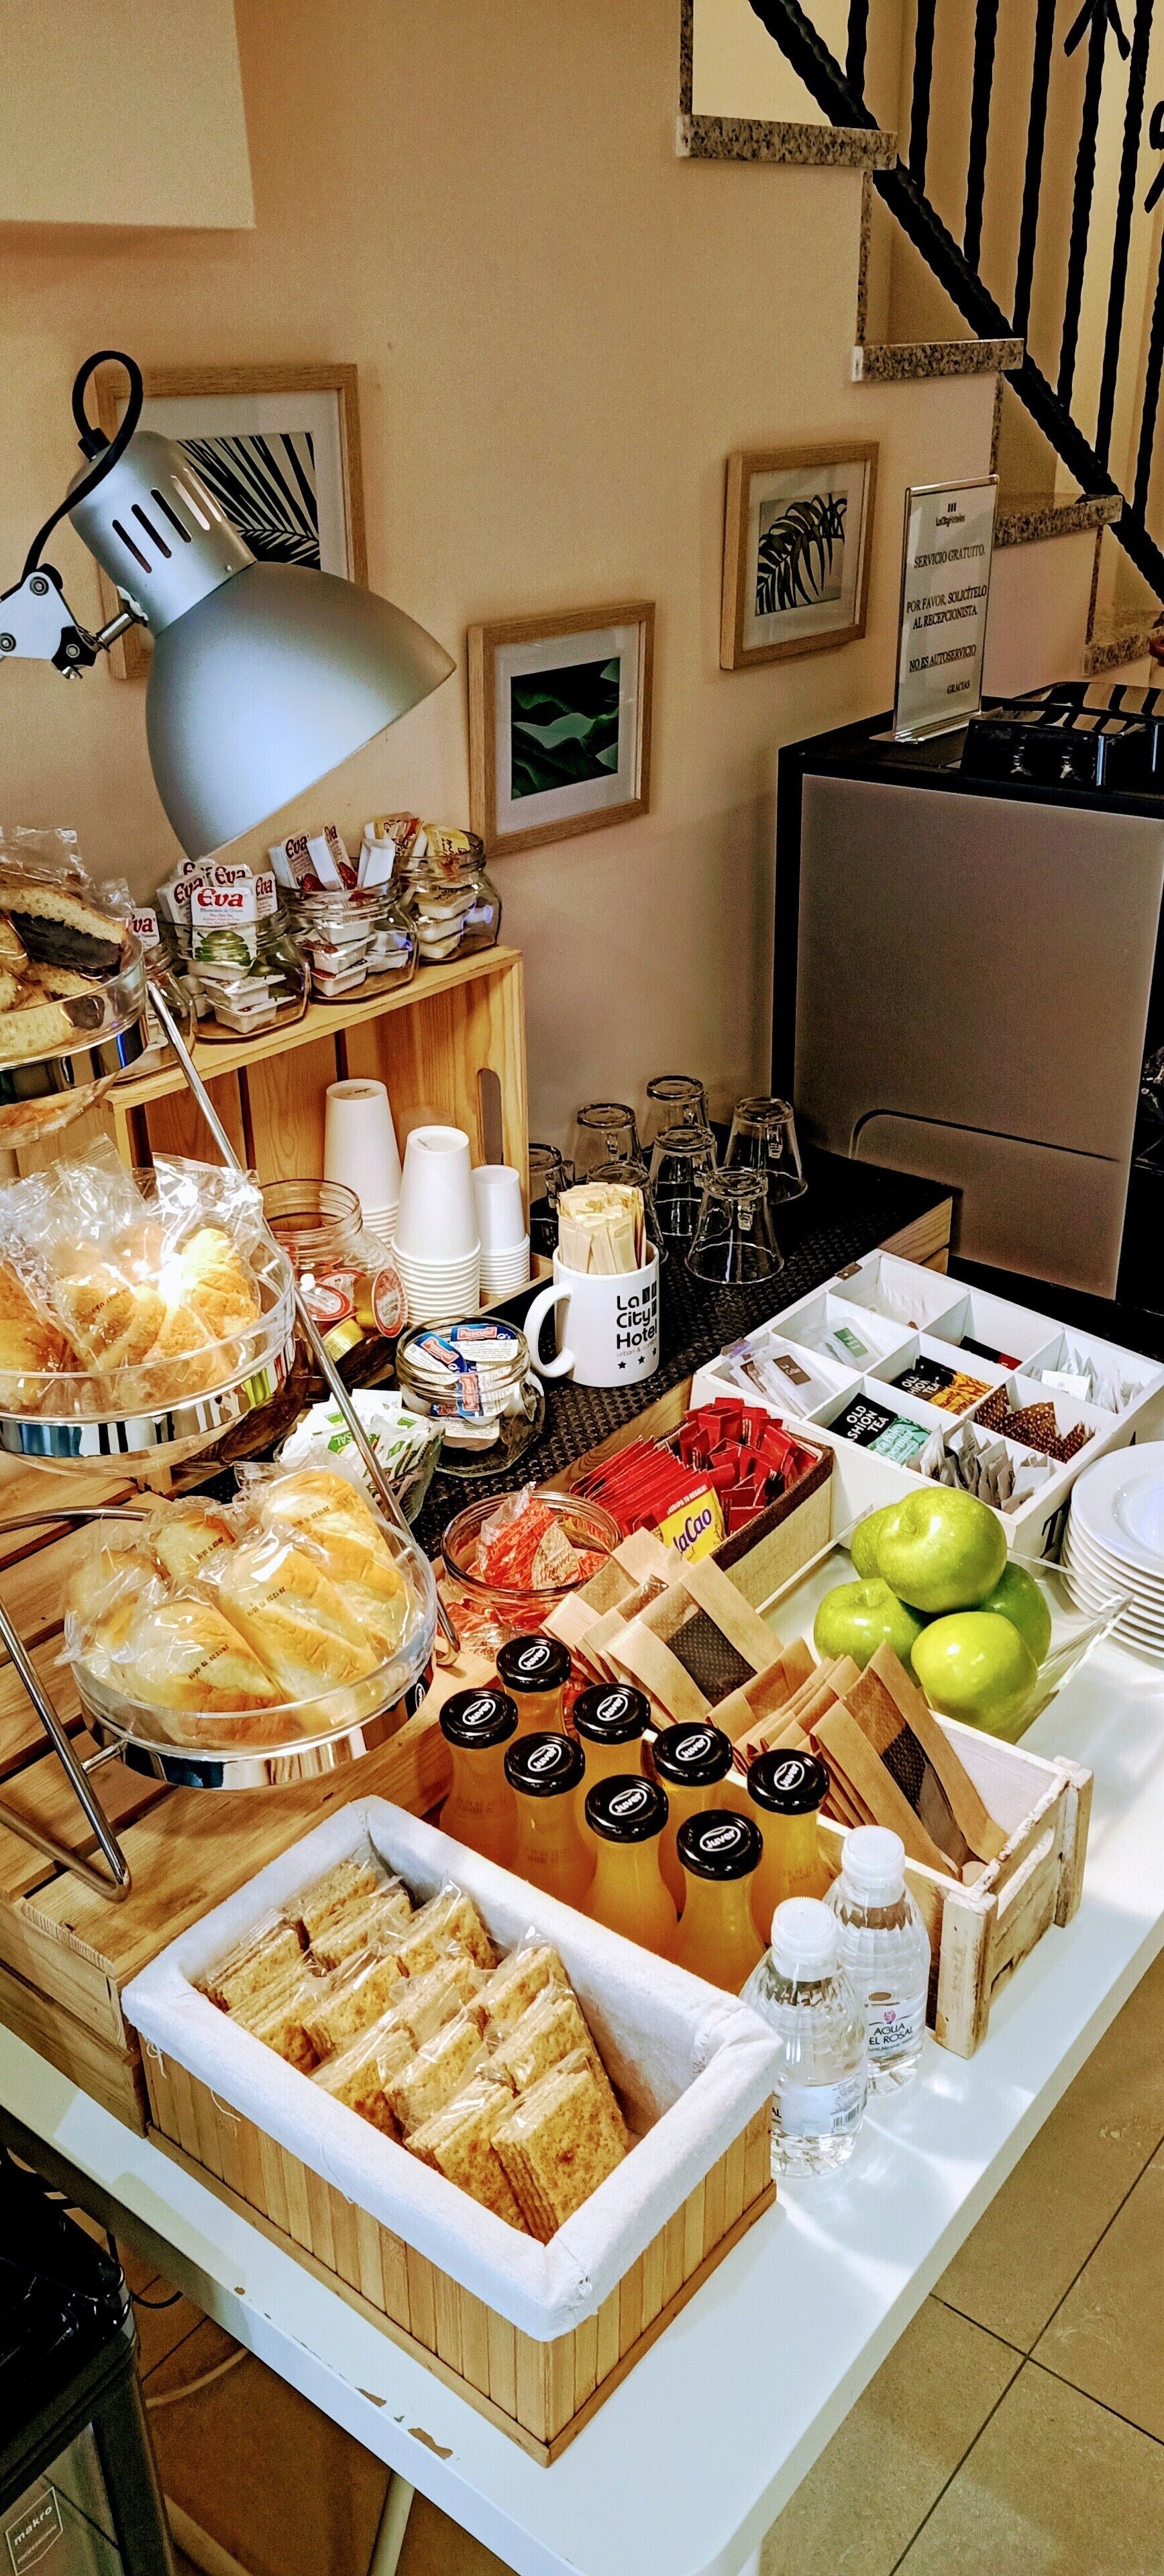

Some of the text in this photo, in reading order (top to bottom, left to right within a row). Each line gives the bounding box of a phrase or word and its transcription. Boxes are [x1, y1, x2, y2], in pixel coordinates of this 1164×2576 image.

[913, 551, 947, 569] SERVICIO
[906, 600, 921, 613] POR
[947, 585, 987, 604] SOLICÍTELO
[913, 616, 923, 629] AL
[909, 644, 977, 672] NO ES AUTOSERVICIO
[947, 680, 971, 694] GRACIAS
[286, 836, 307, 859] Eva
[215, 866, 246, 885] Eva
[174, 877, 204, 904] Eva
[255, 877, 273, 896] Eva
[197, 888, 244, 907] Eva
[132, 914, 154, 932] va
[617, 1295, 640, 1311] La
[617, 1307, 651, 1329] City
[617, 1318, 657, 1350] Hotel
[846, 1405, 867, 1423] OLD
[867, 1416, 889, 1432] TEA
[333, 1432, 352, 1446] SAL
[523, 1648, 545, 1668] Juver
[468, 1702, 491, 1722] Juver
[602, 1697, 624, 1718] Juver
[533, 1746, 557, 1769] Juver
[681, 1737, 706, 1758] Juver
[779, 1764, 799, 1787] Juver
[615, 1792, 642, 1813] Juver
[706, 1829, 736, 1849] Juver
[874, 2023, 905, 2036] AGUA
[884, 2026, 913, 2044] ROSAL
[14, 2506, 52, 2546] makro
